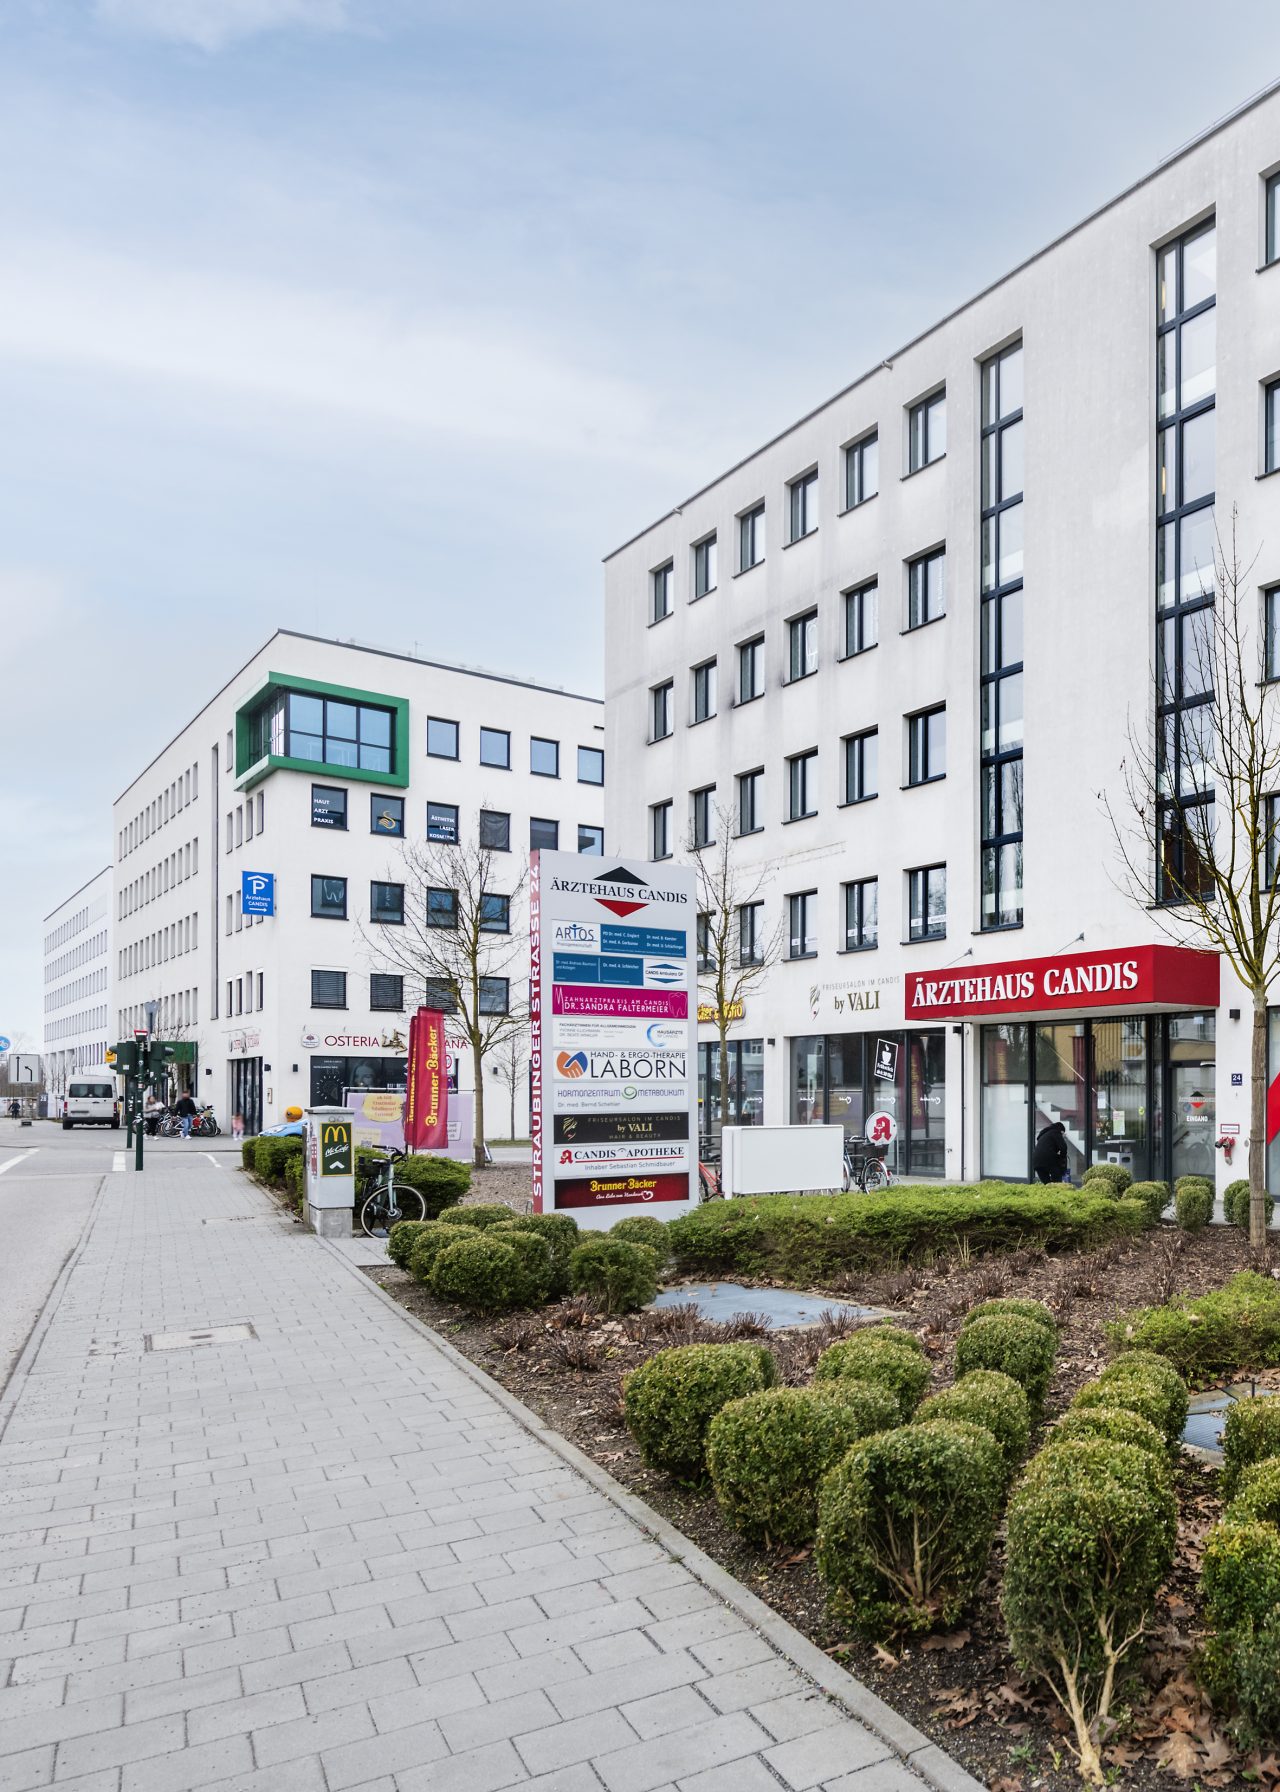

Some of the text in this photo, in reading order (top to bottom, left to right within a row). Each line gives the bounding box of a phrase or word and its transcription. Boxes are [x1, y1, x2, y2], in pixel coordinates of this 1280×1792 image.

[550, 877, 688, 903] ÄRZTEHAUS CANDIS
[555, 924, 594, 941] ARTOS
[911, 961, 1139, 1007] ÄRZTEHAUS CANDIS
[564, 1002, 669, 1013] DR. SANDRA FALTERMEIER
[834, 990, 880, 1014] by VALI
[530, 865, 542, 1197] STRAUBINGER STRASSE 24
[324, 1035, 380, 1047] OSTERIA
[425, 1026, 439, 1126] Brunner Bäcker
[590, 1059, 686, 1078] LABORN
[617, 1123, 653, 1133] by VALI
[574, 1147, 685, 1160] CANDIS APOTHEKE
[590, 1178, 657, 1192] Brunner Bäcker
